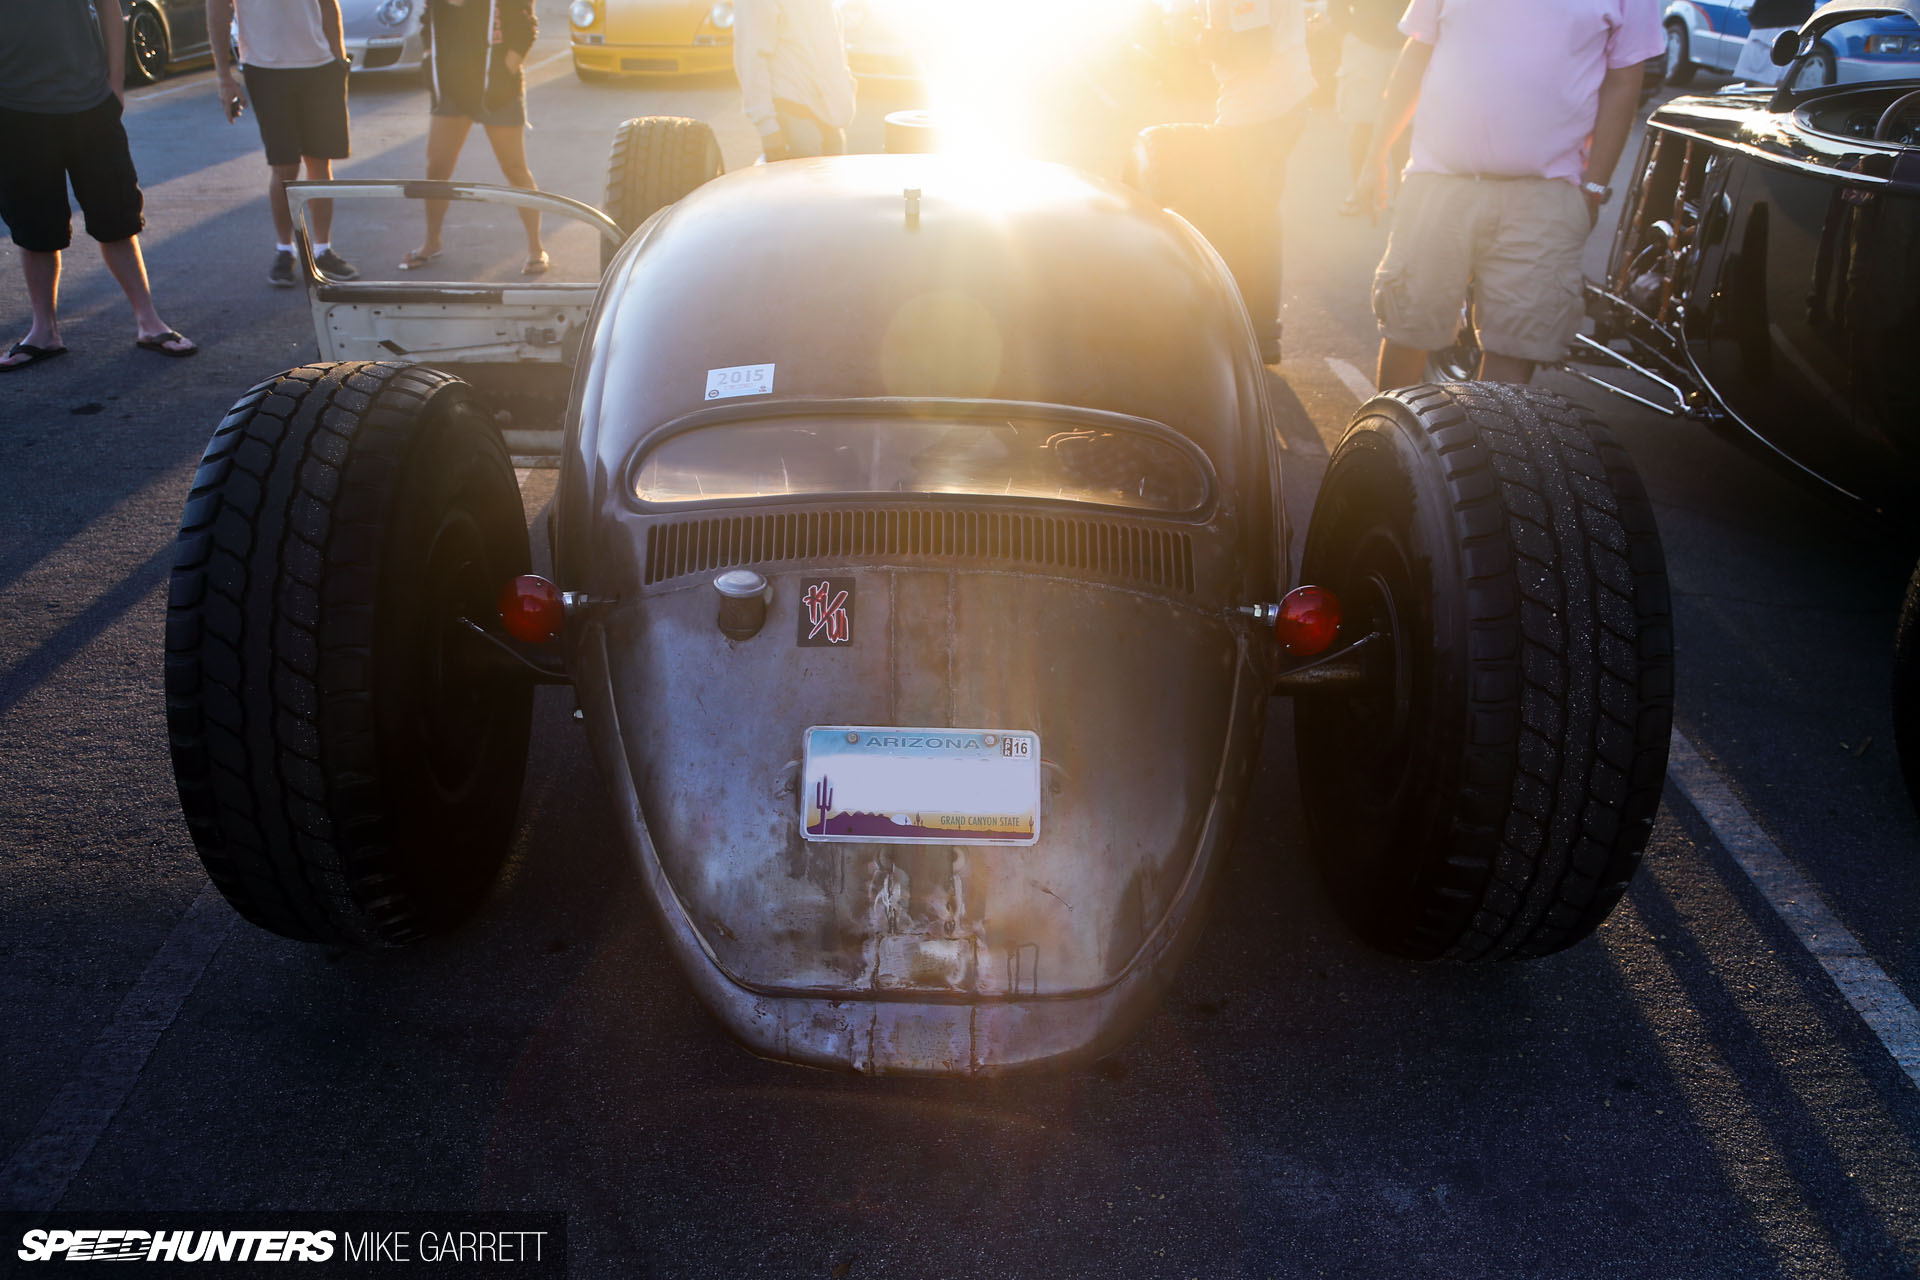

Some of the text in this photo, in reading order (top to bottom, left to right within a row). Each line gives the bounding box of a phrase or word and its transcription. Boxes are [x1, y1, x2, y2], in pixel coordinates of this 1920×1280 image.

[717, 368, 765, 386] 2015
[866, 736, 980, 749] ARIZONA
[1003, 737, 1013, 757] APR
[1013, 742, 1028, 755] 16
[940, 815, 1020, 827] GRAND CANYON STATE
